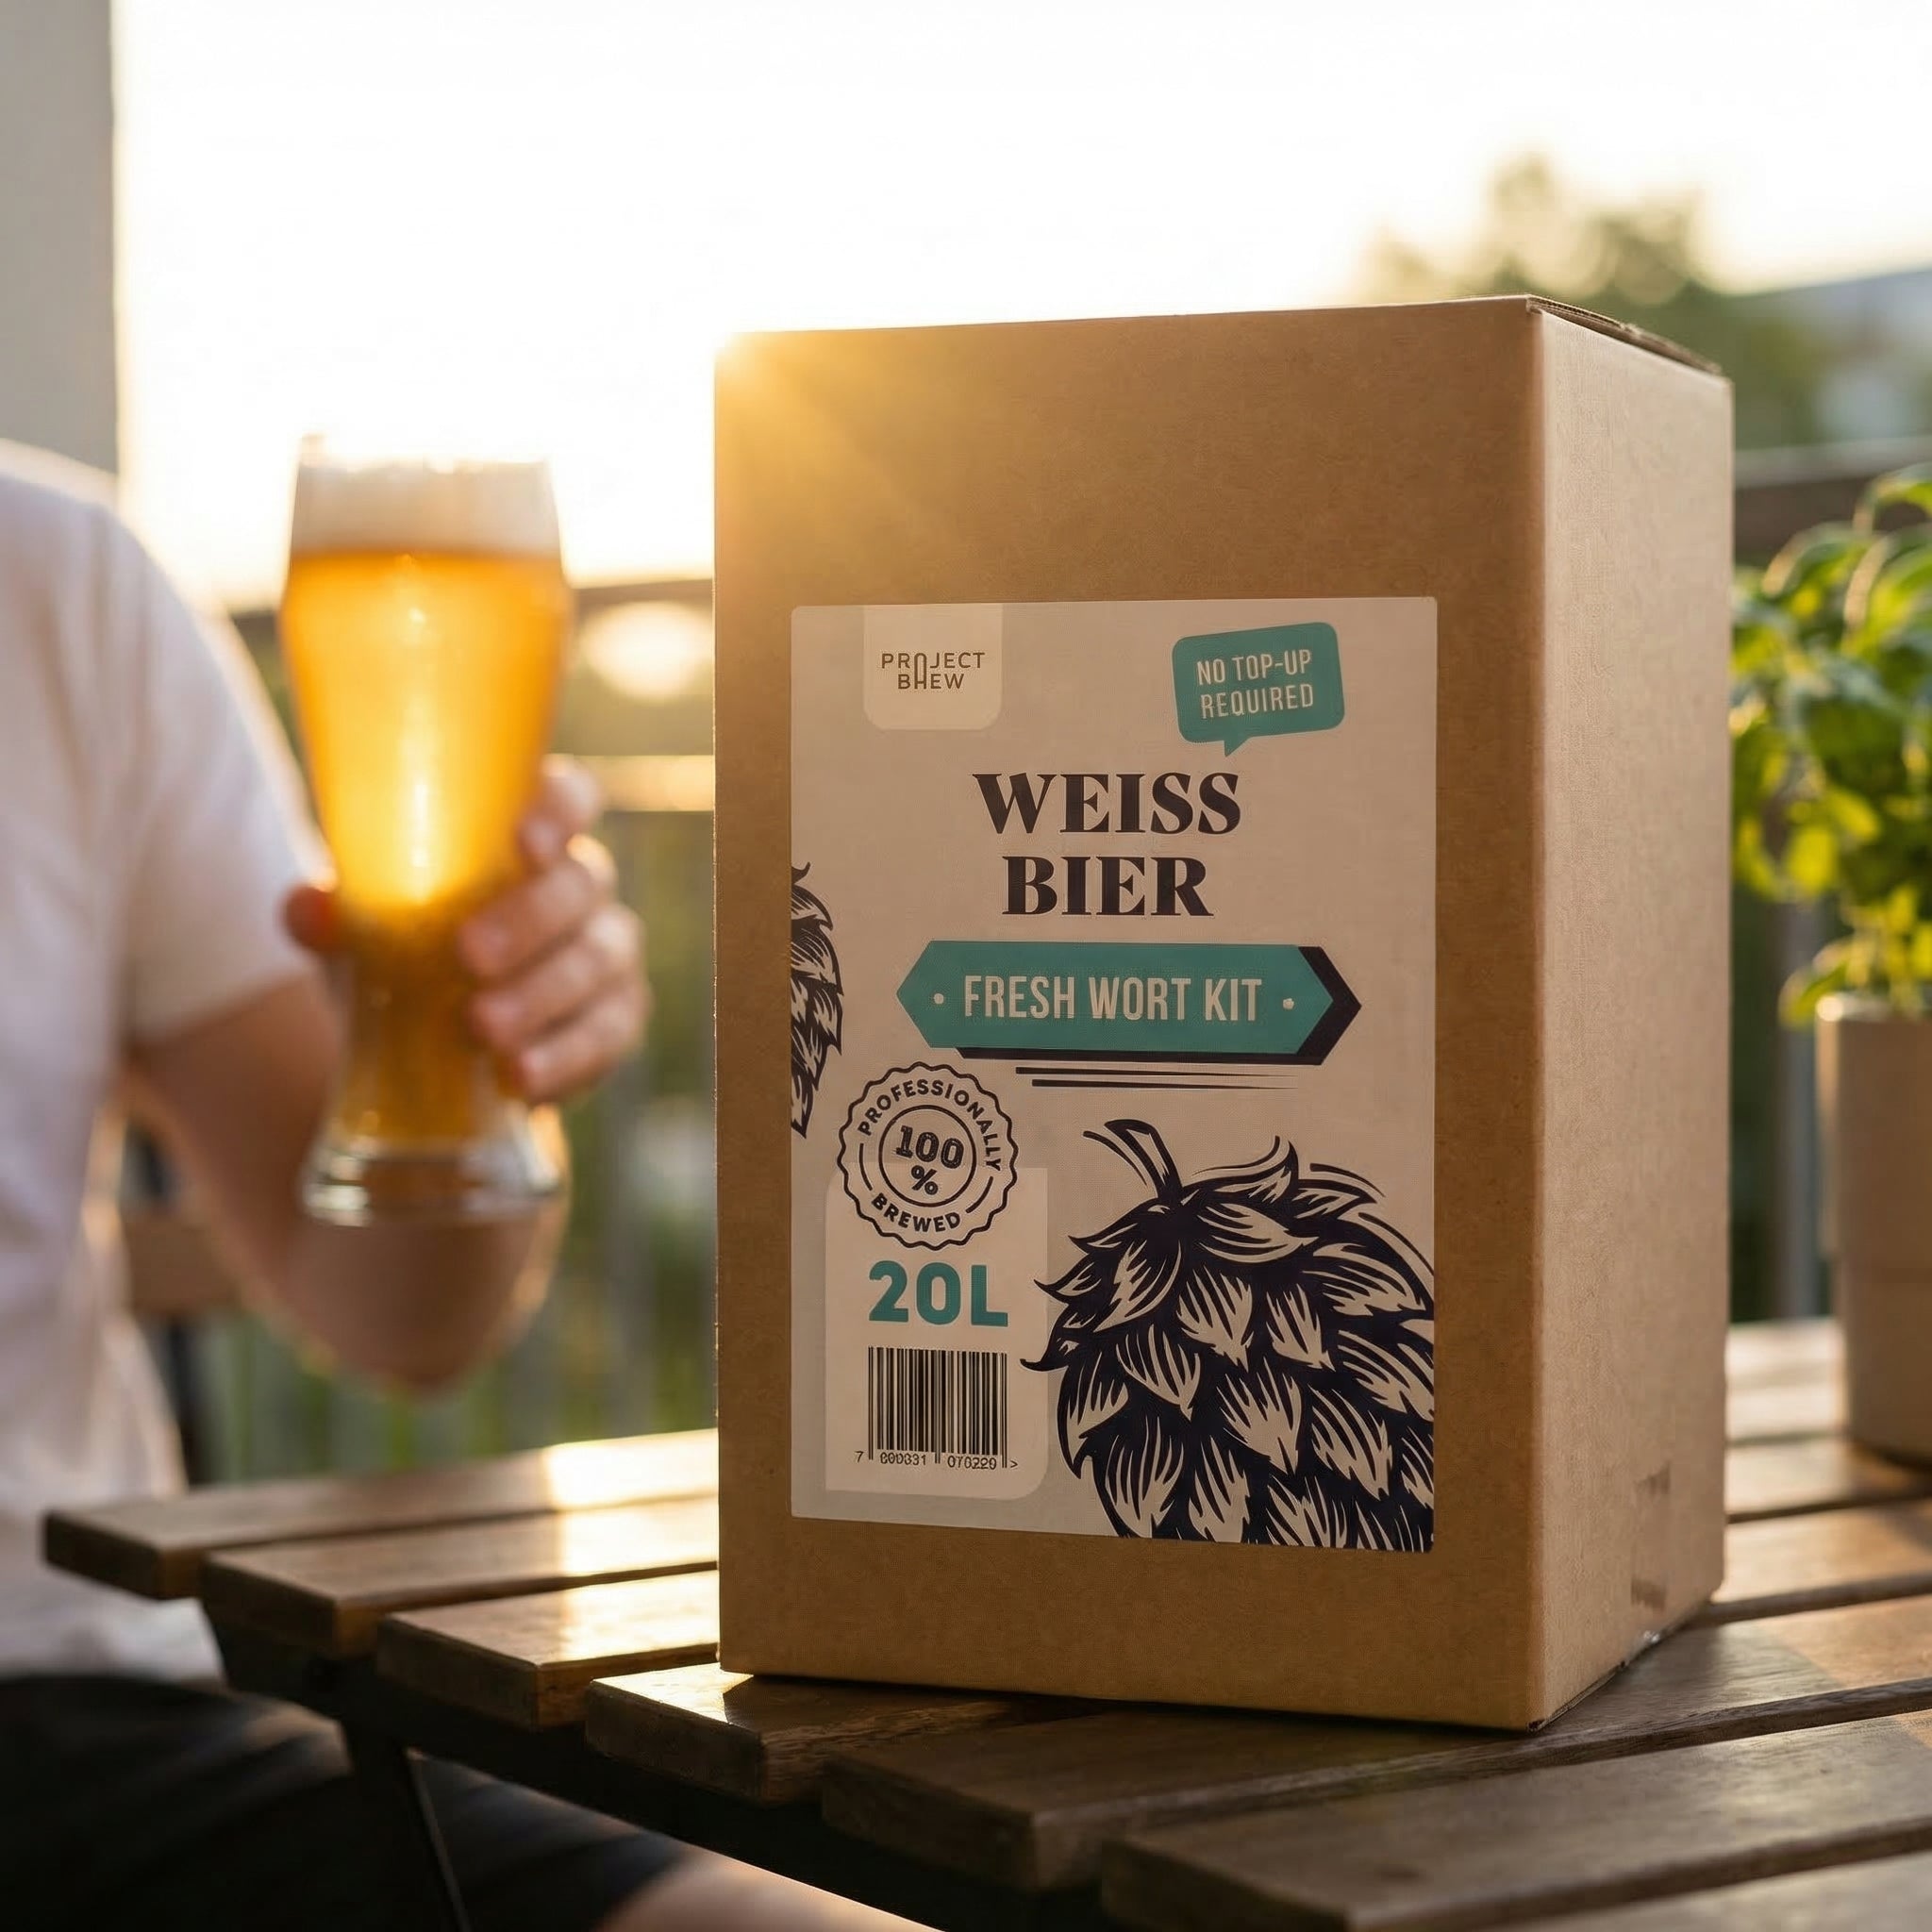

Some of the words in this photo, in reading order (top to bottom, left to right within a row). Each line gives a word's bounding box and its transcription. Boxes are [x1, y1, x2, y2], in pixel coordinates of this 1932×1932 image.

[1196, 658, 1226, 686] NO
[1231, 649, 1312, 681] TOP-UP
[1200, 683, 1315, 720] REQUIRED
[972, 772, 1241, 835] WEISS
[1001, 856, 1215, 917] BIER
[964, 975, 1075, 1019] FRESH
[1088, 976, 1191, 1021] WORT
[1205, 978, 1263, 1021] KIT
[858, 1078, 1002, 1172] PROFESSIONALLY
[895, 1124, 965, 1169] 100
[910, 1164, 939, 1196] %
[872, 1192, 961, 1233] BREWED
[868, 1259, 1009, 1327] 20L
